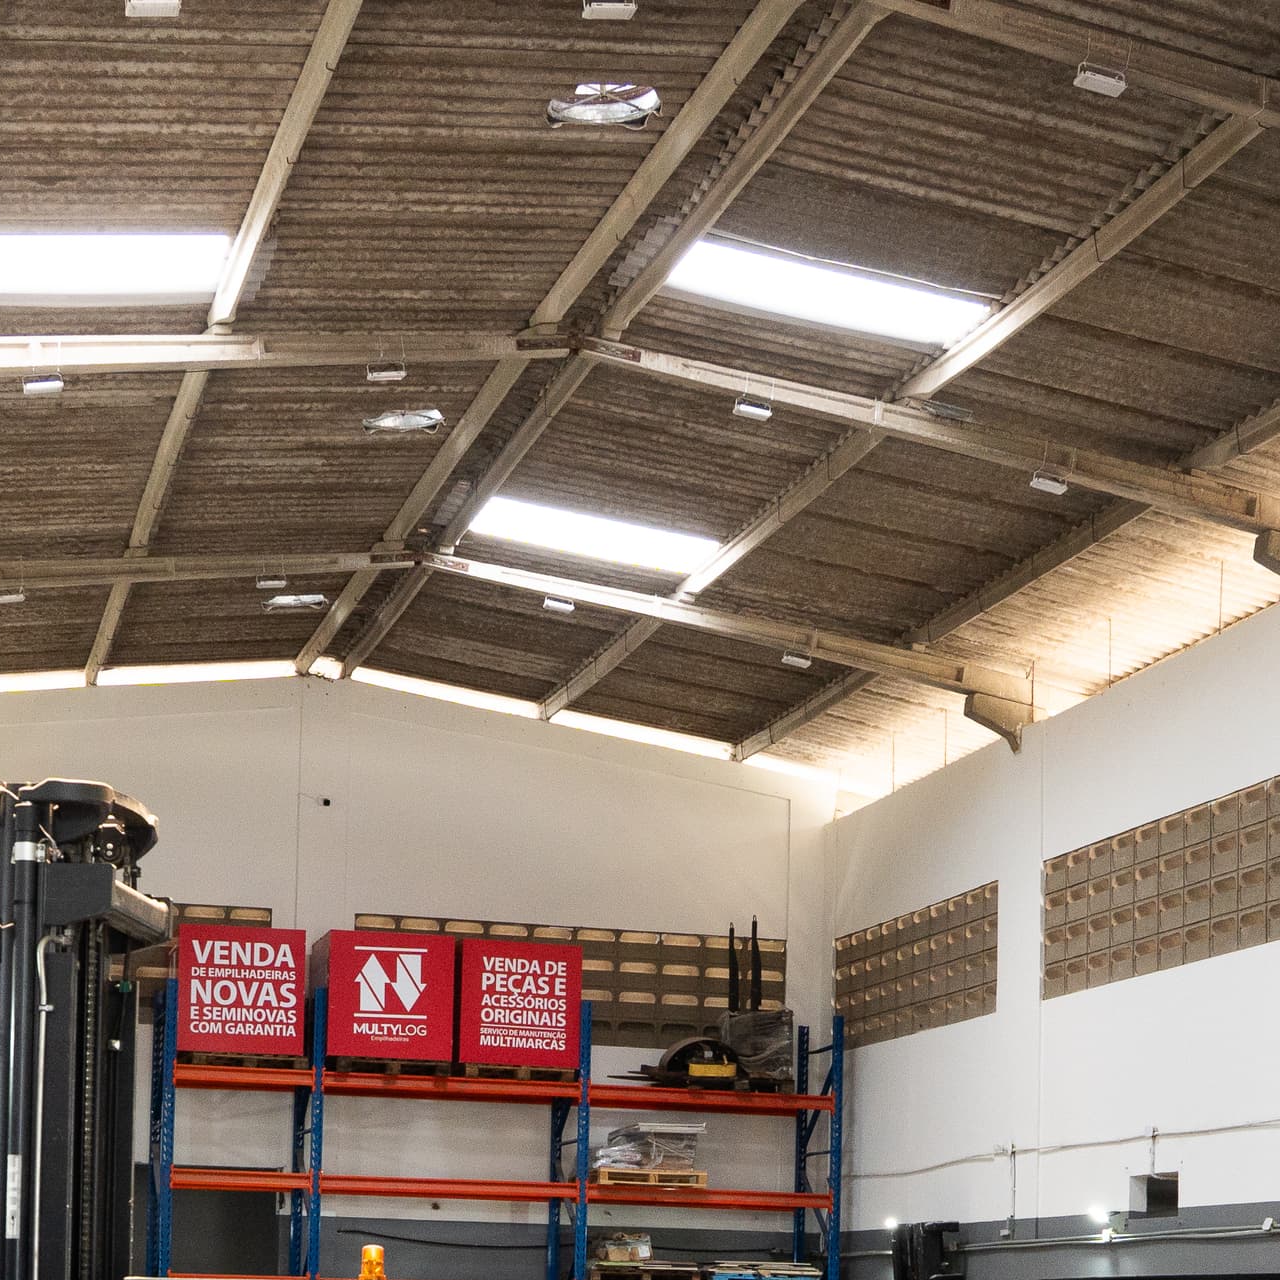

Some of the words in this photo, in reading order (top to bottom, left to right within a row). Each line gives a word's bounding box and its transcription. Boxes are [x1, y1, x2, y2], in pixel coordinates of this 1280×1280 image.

[191, 939, 296, 969] VENDA
[191, 967, 206, 977] DE
[208, 968, 297, 981] EMPILHADEIRAS
[482, 956, 541, 975] VENDA
[545, 961, 567, 977] DE
[190, 979, 297, 1009] NOVAS
[481, 972, 551, 998] PEÇAS
[554, 977, 567, 996] E
[481, 993, 567, 1011] ACESSÓRIOS
[190, 1006, 199, 1020] E
[203, 1006, 297, 1024] SEMINOVAS
[480, 1007, 567, 1027] ORIGINAIS
[190, 1021, 222, 1035] COM
[225, 1022, 297, 1038] GARANTIA
[353, 1022, 427, 1037] MULTYLOG
[480, 1027, 508, 1038] SERVIÇO
[509, 1029, 519, 1037] DE
[519, 1029, 567, 1041] MANUTENÇÃO
[480, 1035, 567, 1051] MULTIMARCAS
